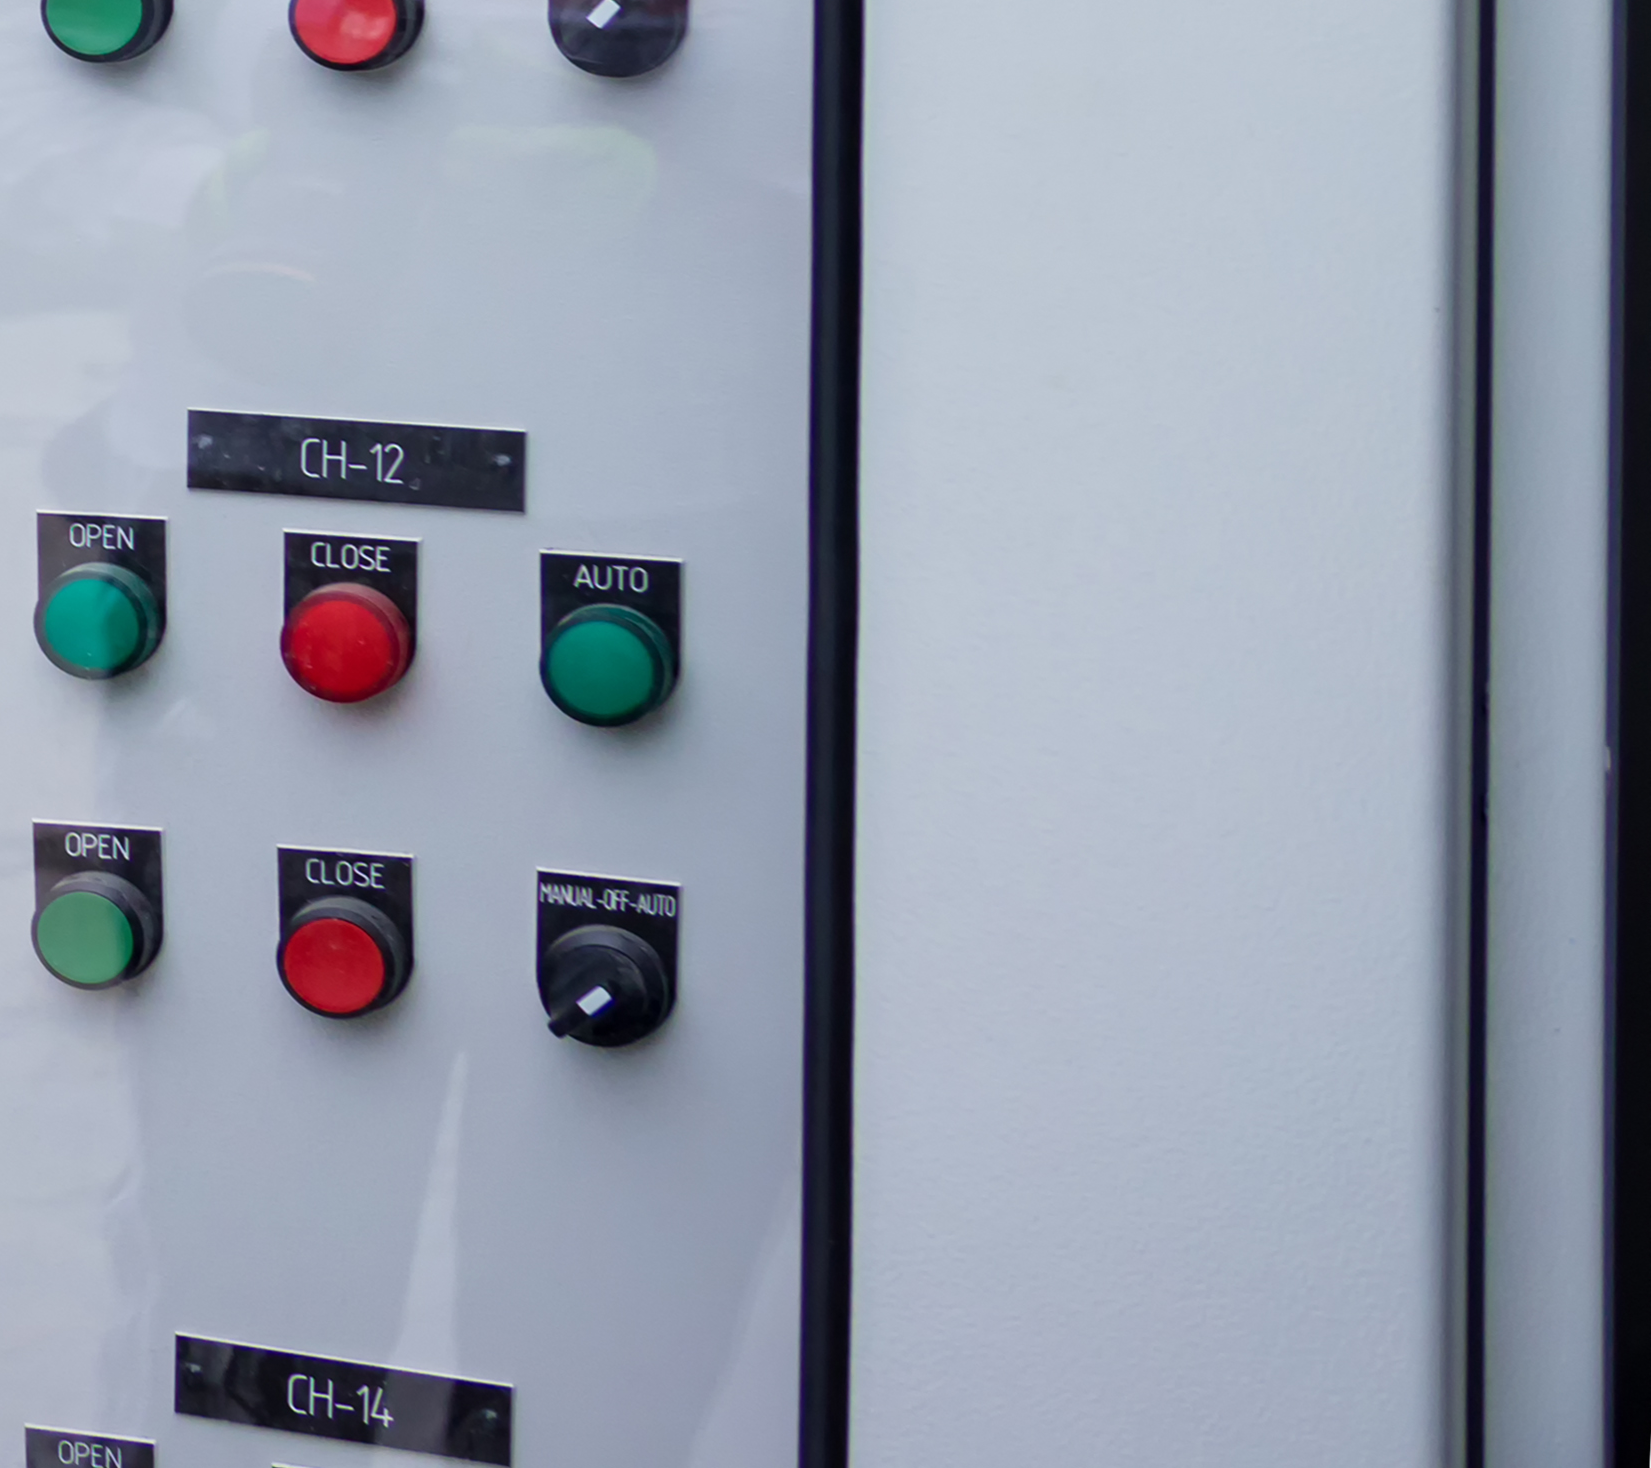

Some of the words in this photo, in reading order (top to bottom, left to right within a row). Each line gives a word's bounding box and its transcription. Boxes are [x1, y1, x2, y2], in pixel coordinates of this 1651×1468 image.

[300, 437, 404, 485] CH-12
[69, 522, 135, 550] OPEN
[310, 541, 391, 573] CLOSE
[573, 564, 649, 593] AUTO
[65, 831, 130, 861] OPEN
[305, 858, 385, 890] CLOSE
[539, 882, 676, 918] MANUAL-OFF-AUTO
[287, 1373, 394, 1428] CH-14
[58, 1440, 122, 1468] OPEN
